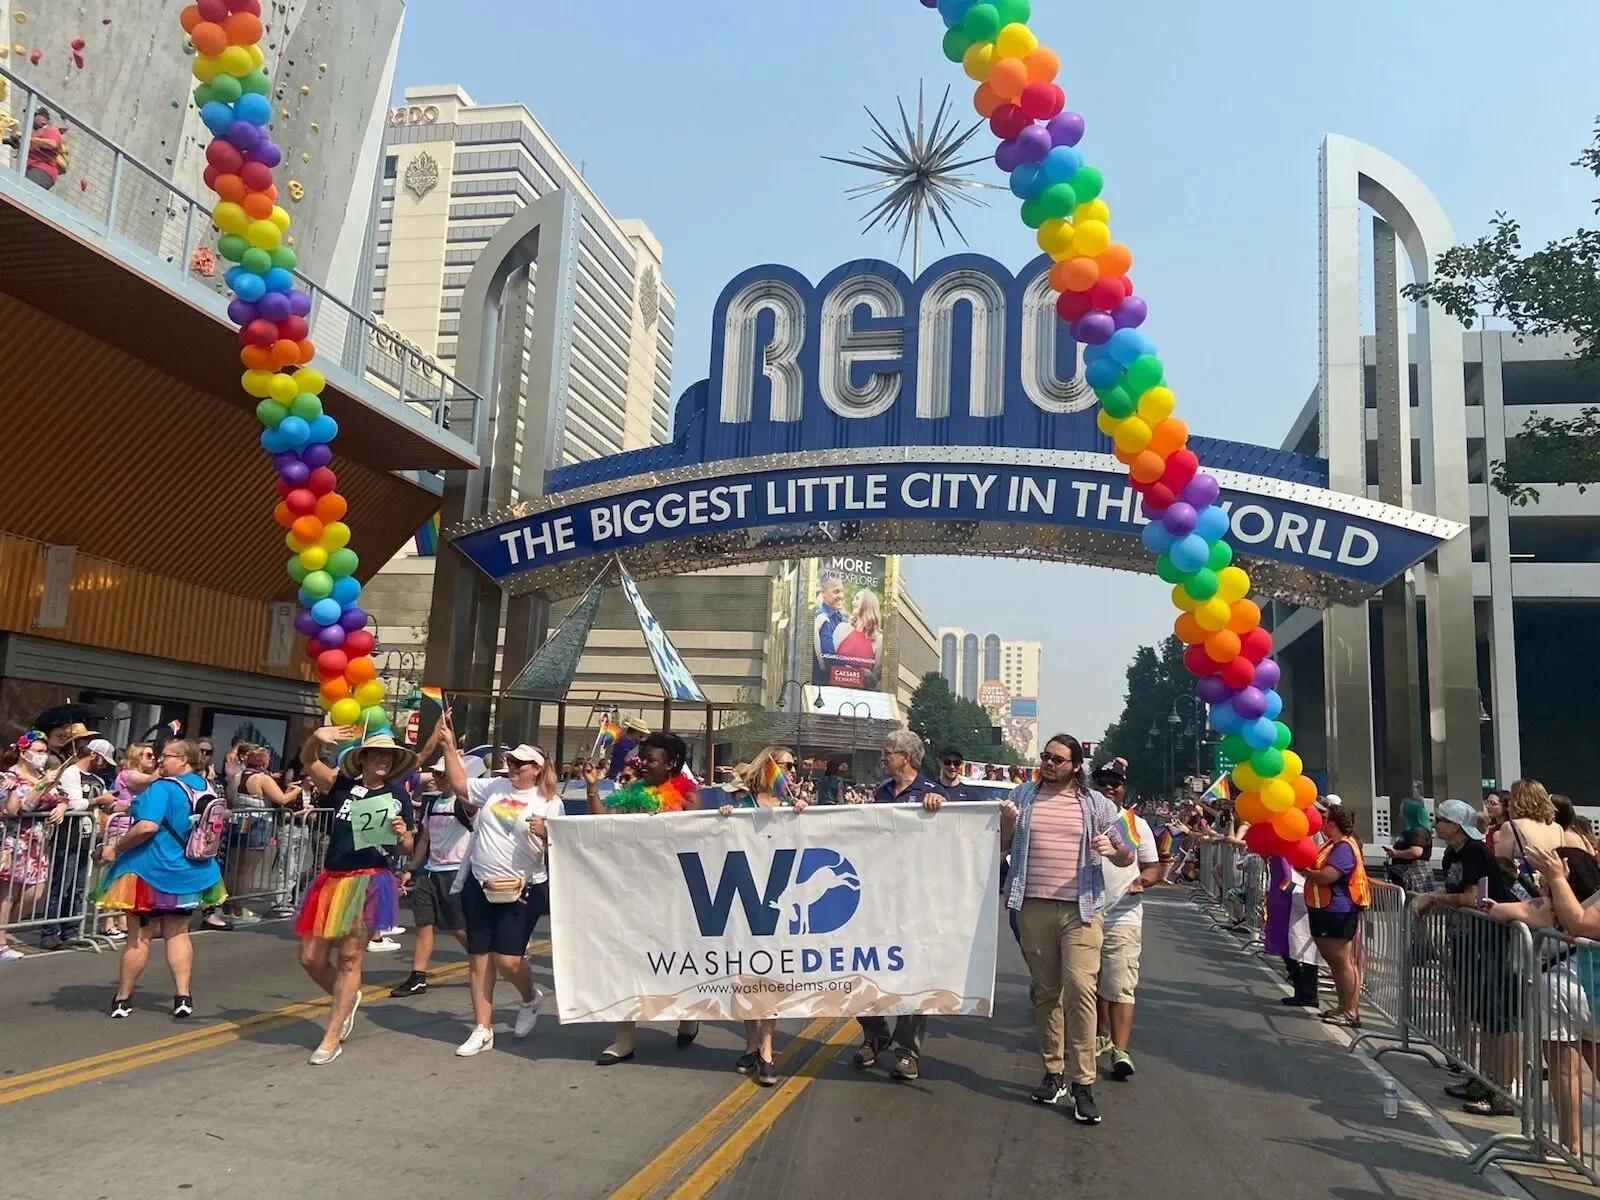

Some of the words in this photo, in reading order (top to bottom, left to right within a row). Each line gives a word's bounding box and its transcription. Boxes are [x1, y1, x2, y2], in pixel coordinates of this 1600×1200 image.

[720, 267, 1100, 423] RENO
[500, 515, 576, 565] THE
[590, 484, 752, 542] BIGGEST
[767, 474, 888, 515] LITTLE
[901, 472, 998, 510] CITY
[1007, 475, 1057, 515] IN
[1218, 500, 1379, 567] ORLD
[832, 555, 873, 575] MORE
[824, 569, 838, 582] TO
[839, 571, 878, 588] EXPLORE
[834, 669, 861, 678] CAESARS
[359, 807, 390, 832] 27
[646, 944, 905, 976] WASHOEDEMS
[696, 978, 853, 994] www.washoedems.org
